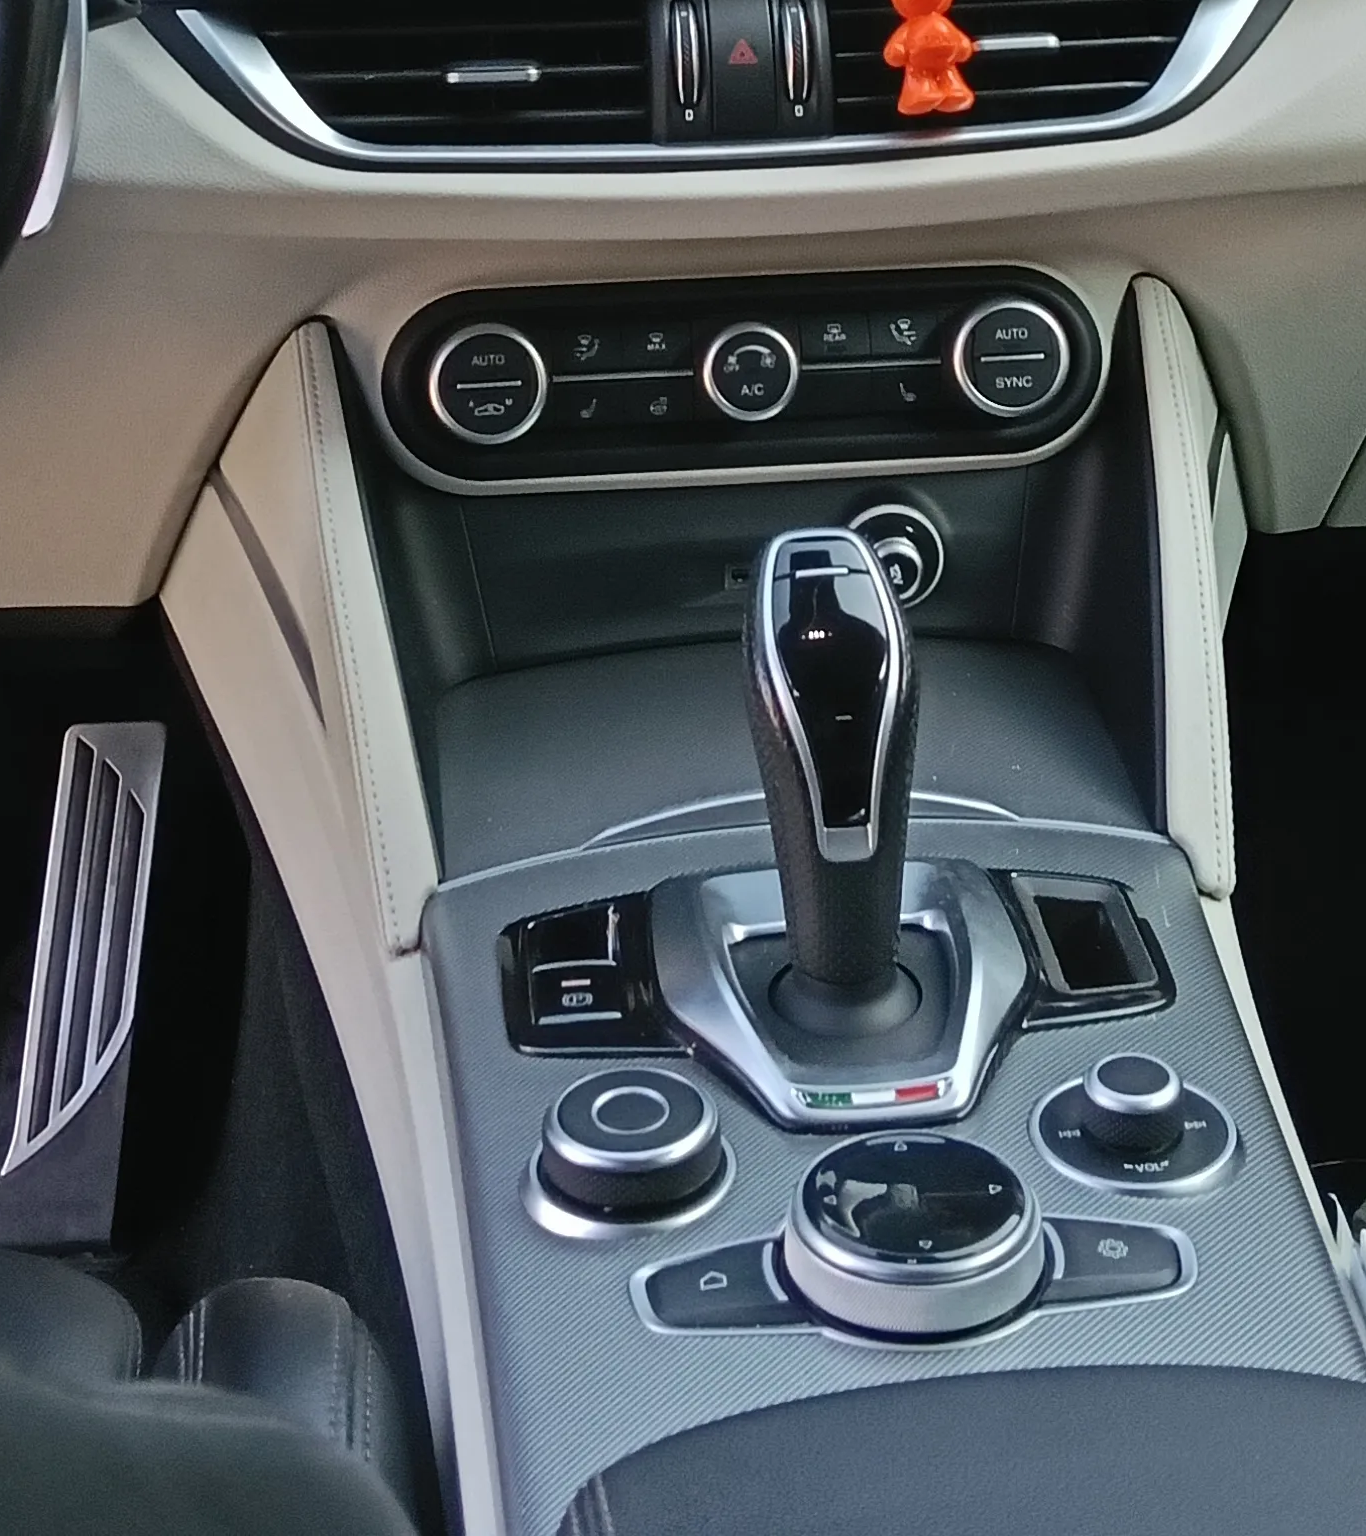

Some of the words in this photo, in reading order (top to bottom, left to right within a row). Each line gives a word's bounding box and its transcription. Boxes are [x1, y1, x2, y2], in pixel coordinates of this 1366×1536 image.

[994, 327, 1028, 341] AUTO
[470, 354, 506, 367] AUTO
[740, 382, 765, 397] A/C
[995, 375, 1033, 390] SYNC
[1134, 1161, 1163, 1173] VOL
